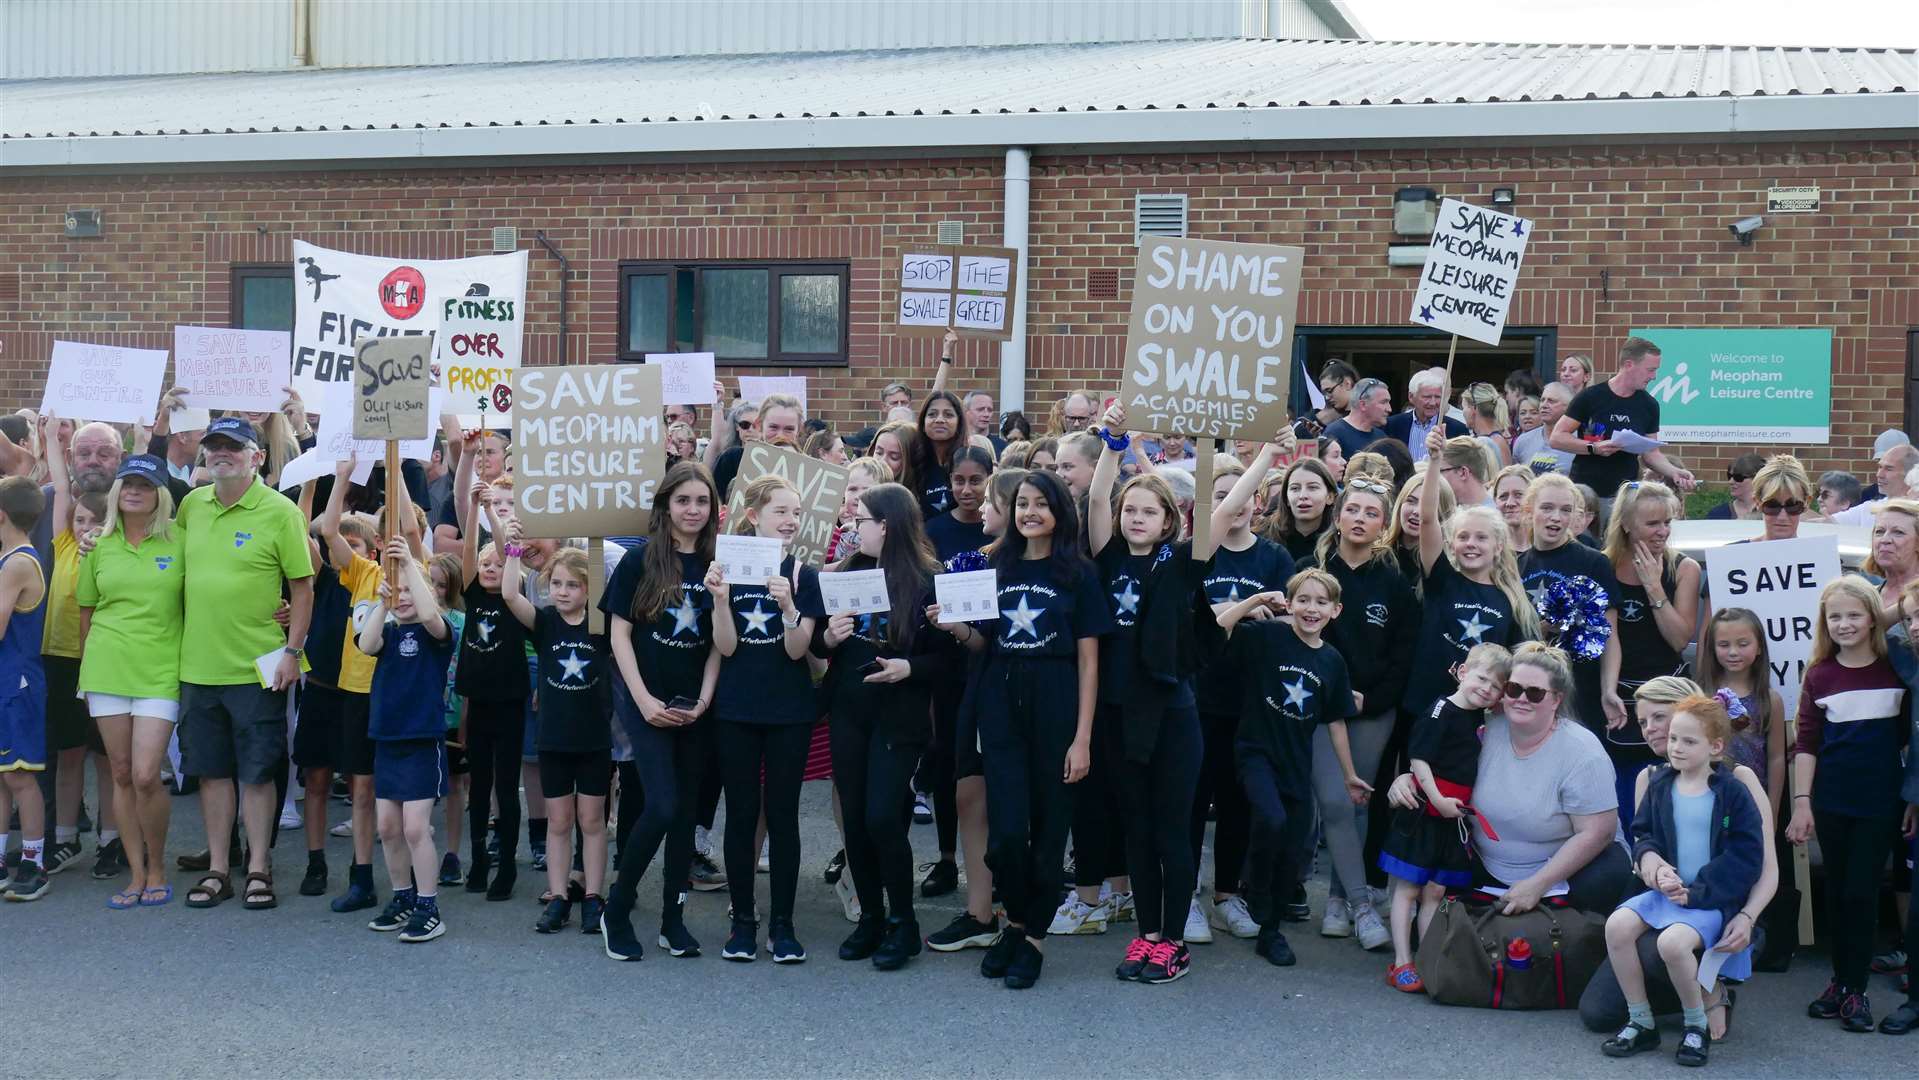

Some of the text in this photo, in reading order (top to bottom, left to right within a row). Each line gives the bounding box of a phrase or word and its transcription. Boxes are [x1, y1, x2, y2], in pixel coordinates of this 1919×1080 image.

[1450, 206, 1508, 240] SAVE
[1432, 232, 1518, 270] MEOPHAM
[904, 260, 951, 281] STOP
[963, 262, 1007, 284] THE
[1147, 245, 1287, 297] SHAME
[1428, 262, 1508, 299] LEISURE
[445, 299, 514, 321] FITNESS
[903, 298, 948, 319] SWALE
[956, 300, 1003, 323] GREED
[1432, 293, 1499, 326] CENTRE
[1144, 303, 1283, 349] ON YOU
[197, 334, 247, 356] SAVE
[450, 332, 503, 359] OVER
[1710, 352, 1784, 364] Welcome to
[181, 357, 272, 377] MEOPHAM
[294, 346, 354, 382] FOR
[358, 341, 422, 396] Save
[1132, 343, 1281, 403] SWALE
[1711, 369, 1782, 384] Meopham
[193, 379, 271, 398] LEISURE
[448, 367, 512, 393] PROFIT
[519, 368, 641, 410] SAVE
[1710, 386, 1814, 399] Leisure Centre
[1130, 393, 1257, 421] ACADEMIES
[520, 413, 659, 448] MEOPHAM
[1147, 413, 1243, 436] TRUST
[1664, 430, 1791, 440] www.meophamleisure.com
[522, 448, 644, 477] LEISURE
[743, 446, 844, 512] SAVE
[521, 480, 656, 514] CENTRE
[1005, 584, 1030, 593] Amelia
[1030, 584, 1057, 598] Appleby
[1727, 563, 1816, 595] SAVE
[1766, 616, 1812, 642] UR
